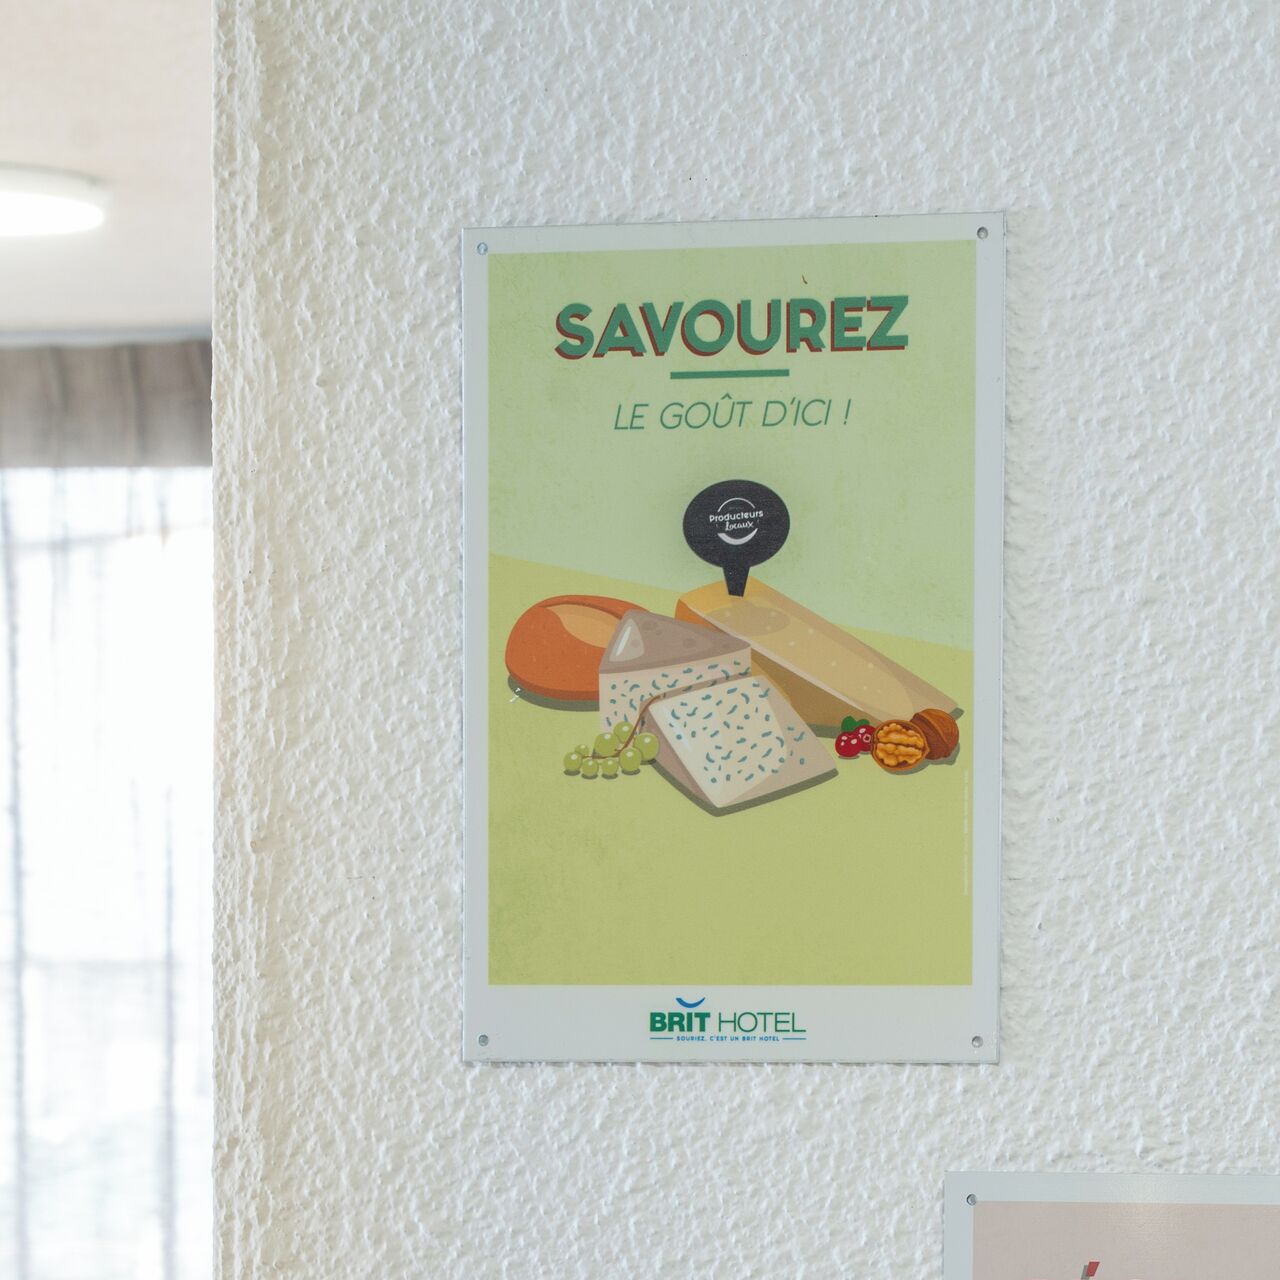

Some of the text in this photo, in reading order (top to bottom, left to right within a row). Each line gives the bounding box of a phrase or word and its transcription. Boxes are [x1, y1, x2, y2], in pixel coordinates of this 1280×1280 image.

[554, 295, 909, 360] SAVOUREZ
[613, 393, 853, 431] LE GOÛT D'ICI !
[709, 509, 764, 524] Producteurs
[725, 520, 754, 532] Locaux
[649, 1012, 807, 1033] BRIT HOTEL
